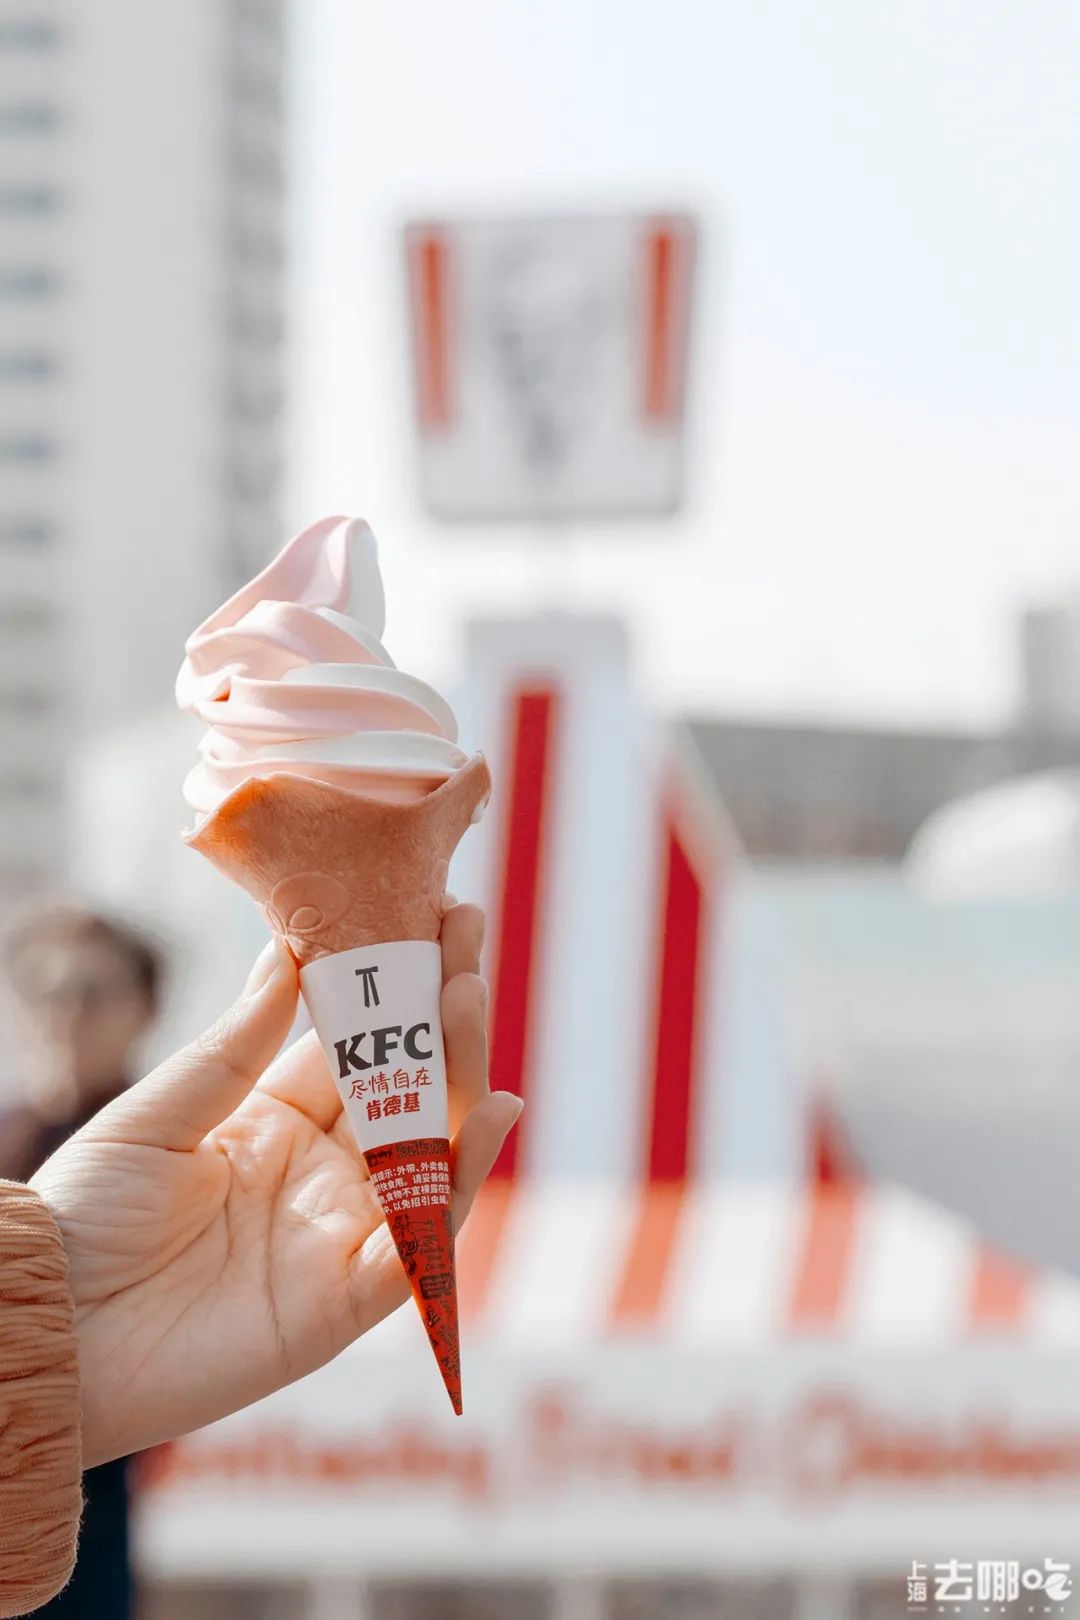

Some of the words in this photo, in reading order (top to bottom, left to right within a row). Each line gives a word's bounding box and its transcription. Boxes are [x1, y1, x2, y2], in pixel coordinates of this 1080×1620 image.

[334, 1022, 433, 1079] KFC
[349, 1066, 432, 1099] 尽情自在
[366, 1091, 420, 1121] 肯德基
